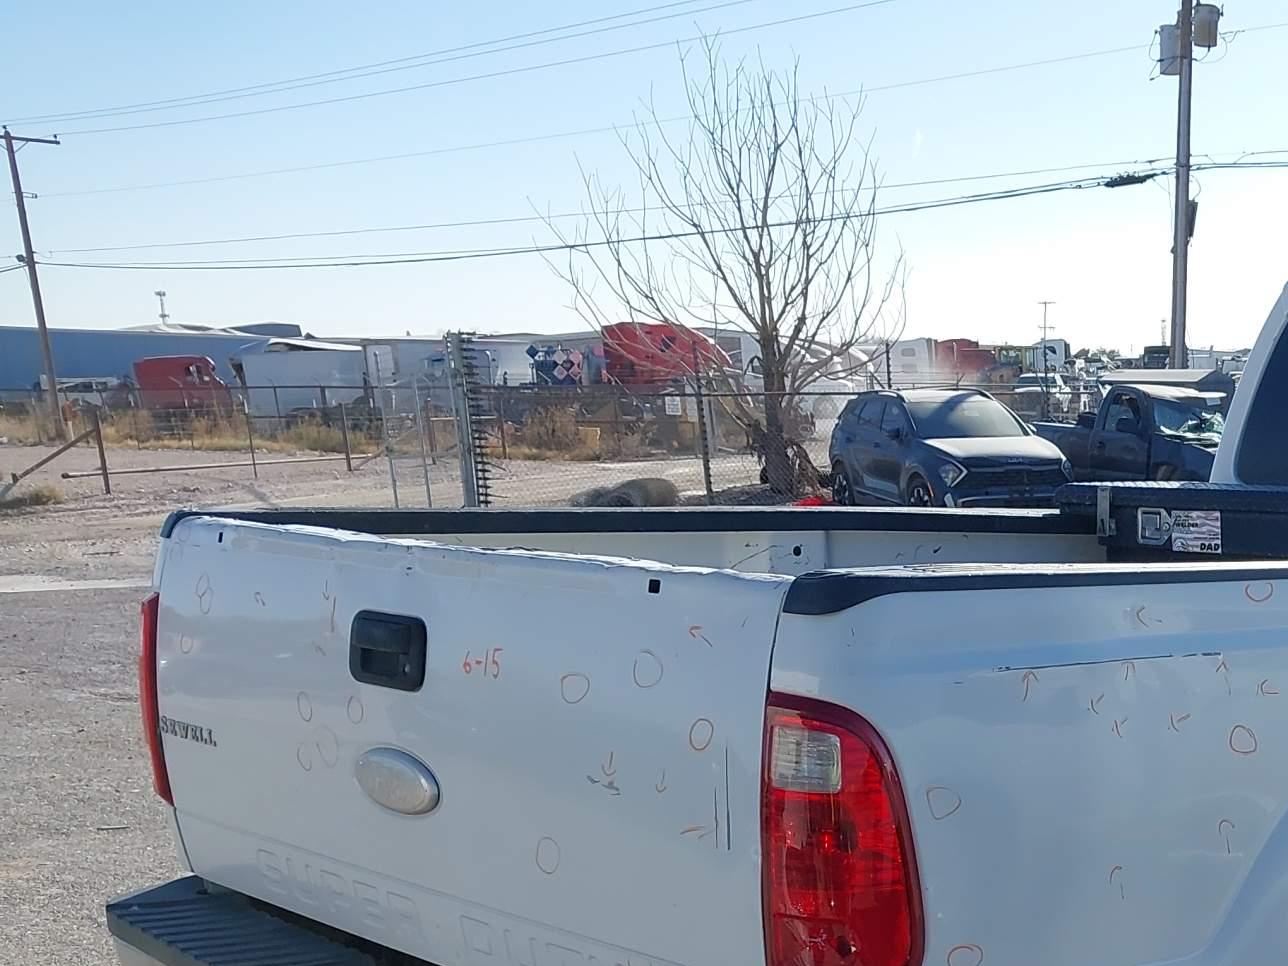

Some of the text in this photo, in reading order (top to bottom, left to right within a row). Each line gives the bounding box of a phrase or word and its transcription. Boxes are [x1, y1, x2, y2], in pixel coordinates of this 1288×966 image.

[1200, 542, 1220, 551] DAD
[463, 648, 504, 680] 6-15
[160, 715, 217, 747] SEWELL
[256, 847, 430, 946] SUPER
